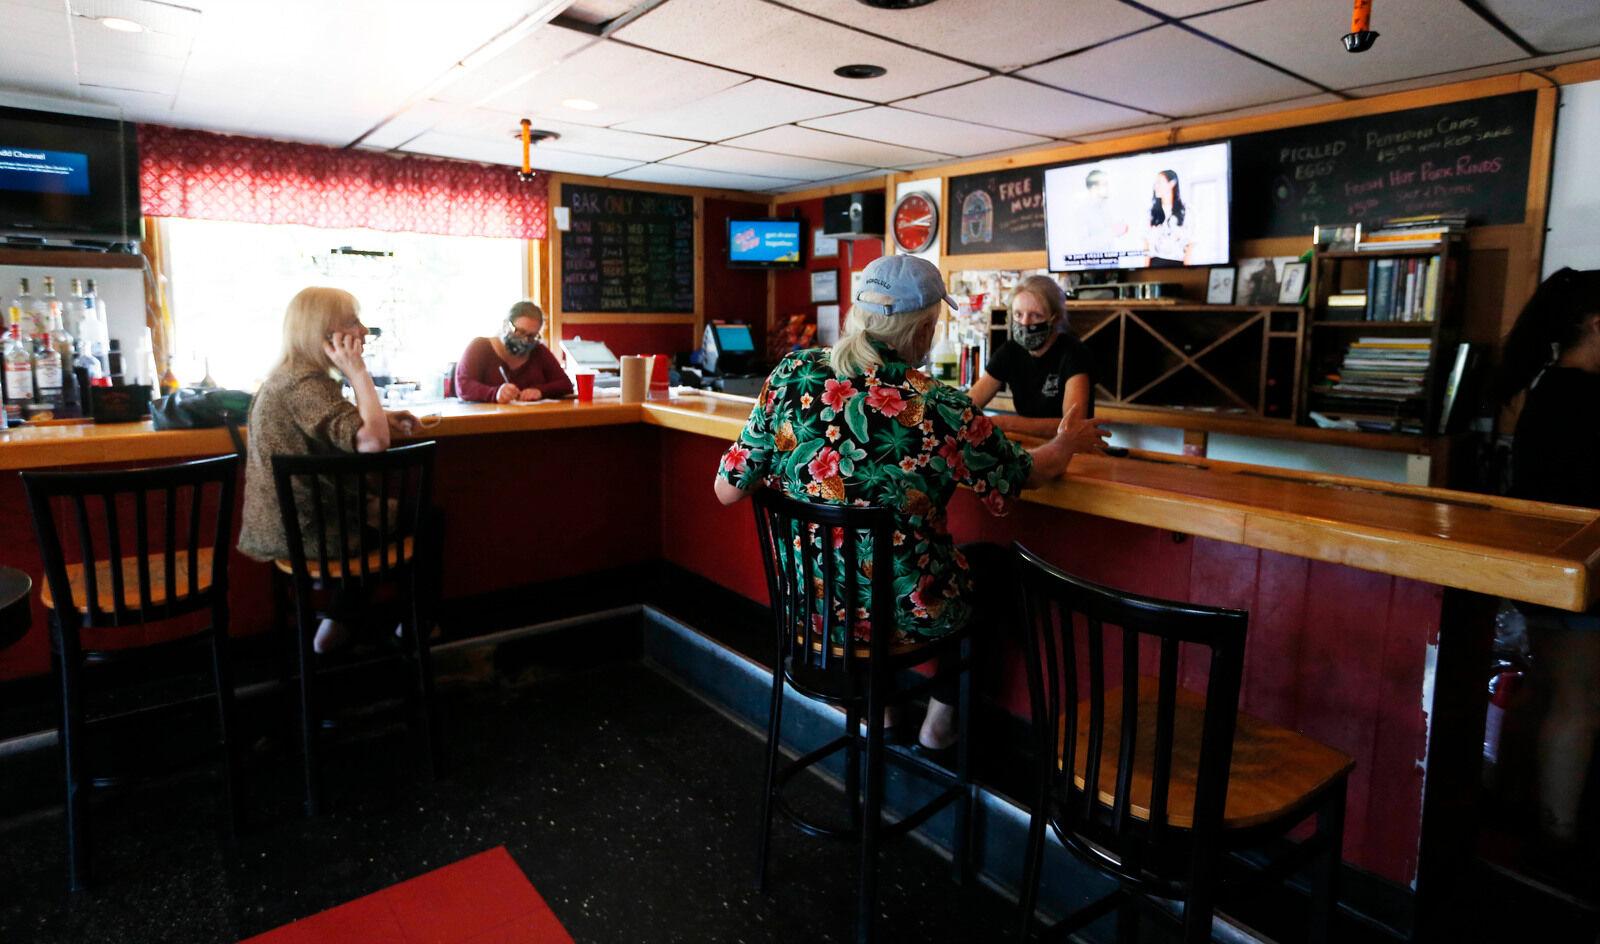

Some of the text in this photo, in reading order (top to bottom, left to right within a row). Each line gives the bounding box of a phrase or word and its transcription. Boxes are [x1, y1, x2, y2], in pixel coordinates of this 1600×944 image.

[1280, 140, 1346, 162] PICKLED
[1295, 160, 1335, 181] EGGS
[999, 177, 1032, 202] FREE
[572, 192, 601, 214] BAR
[603, 194, 634, 216] ONLY
